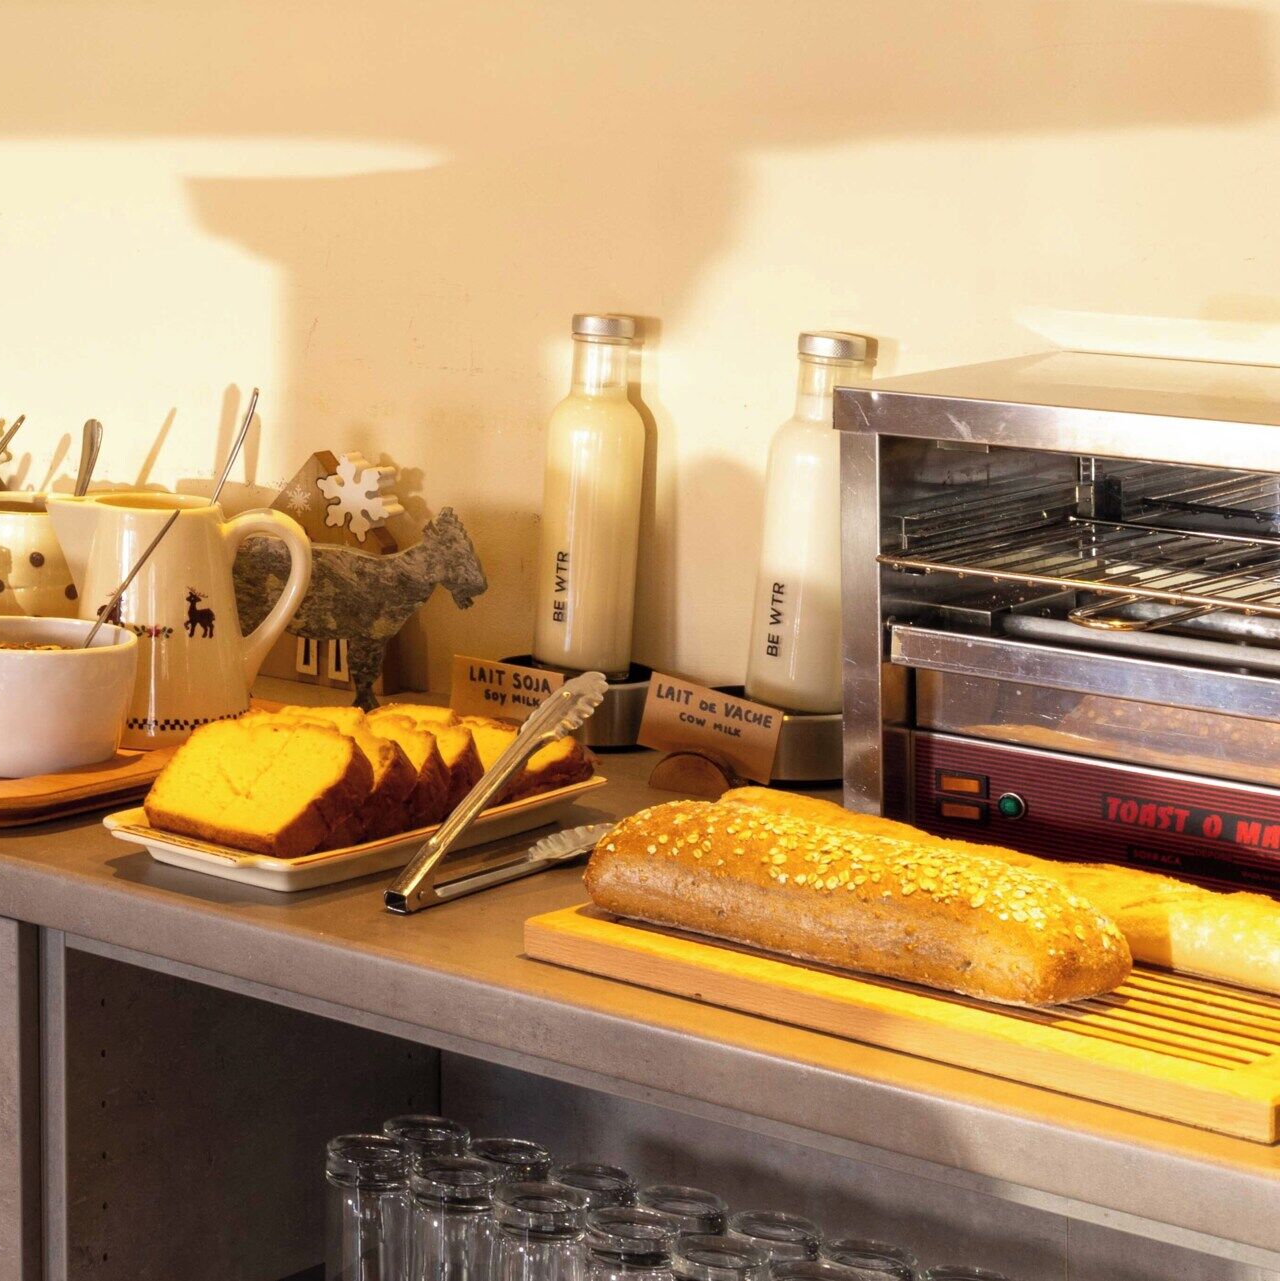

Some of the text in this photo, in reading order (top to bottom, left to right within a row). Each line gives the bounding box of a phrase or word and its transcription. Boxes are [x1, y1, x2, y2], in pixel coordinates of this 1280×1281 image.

[553, 551, 569, 622] BE WTR
[766, 582, 785, 657] BE WTR
[469, 665, 552, 696] LAIT SOJA
[511, 693, 540, 707] MILK
[656, 683, 773, 729] LAIT DE VACHE
[679, 712, 742, 737] COW MILK
[1107, 797, 1190, 833] TOAST
[1202, 814, 1223, 838] O
